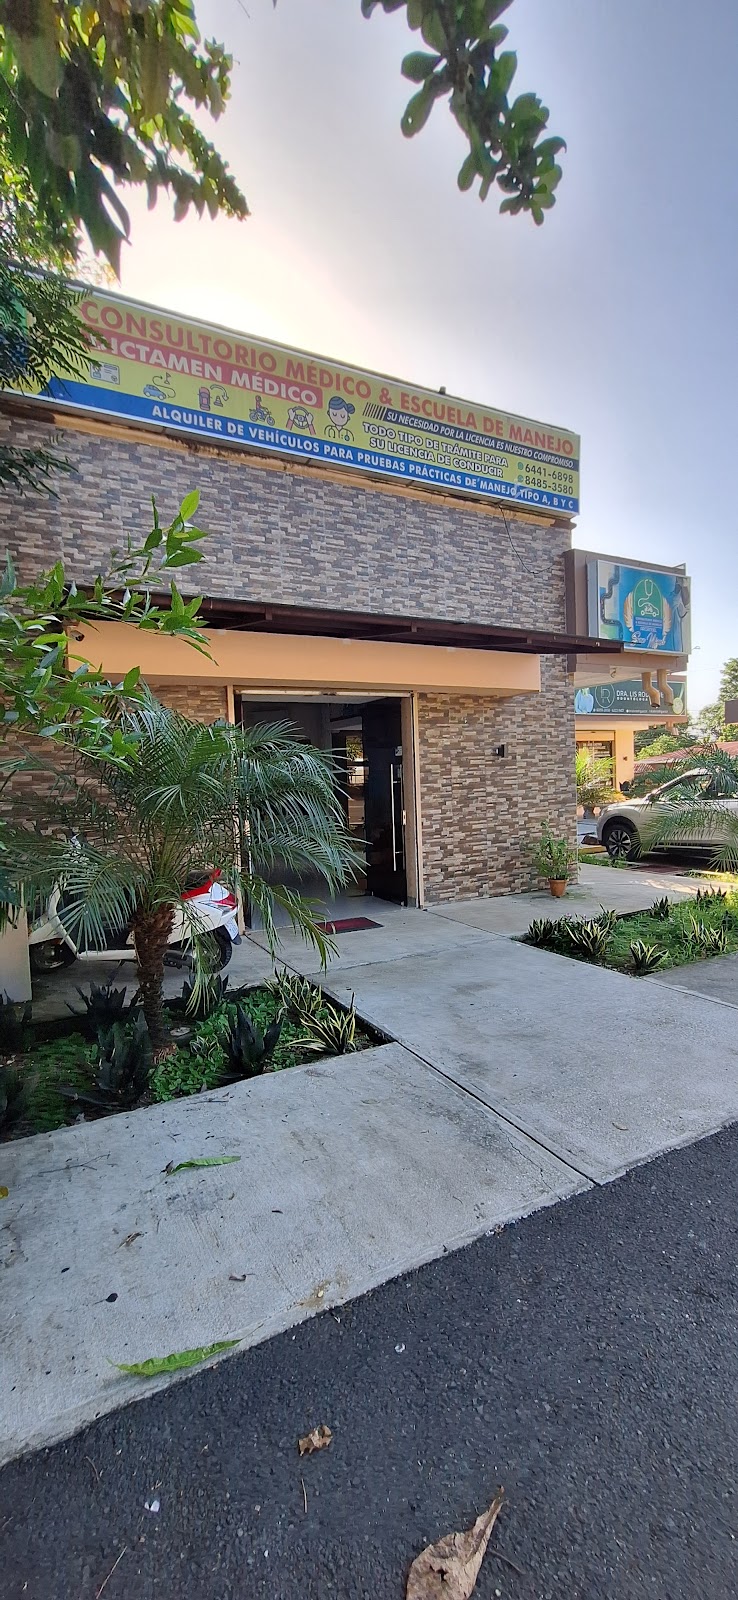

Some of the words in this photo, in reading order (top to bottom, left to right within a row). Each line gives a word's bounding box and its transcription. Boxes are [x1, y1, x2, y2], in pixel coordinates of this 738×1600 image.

[81, 301, 277, 373] CONSULTORIO
[285, 358, 371, 400] MÉDICO
[379, 387, 393, 406] &
[401, 392, 477, 430] ESCUELA
[483, 416, 503, 437] DE
[509, 424, 574, 456] MANEJO
[231, 371, 317, 406] MÉDICO
[362, 422, 396, 439] TODO
[398, 431, 423, 446] TIPO
[426, 438, 439, 450] DE
[441, 442, 482, 461] TRÁMITE
[484, 453, 508, 468] PARA
[387, 411, 398, 422] SU
[398, 414, 439, 433] NECESIDAD
[440, 426, 454, 438] POR
[455, 430, 464, 441] LA
[465, 432, 495, 448] LICENCIA
[496, 440, 504, 450] ES
[505, 442, 532, 458] NUESTRO
[152, 405, 223, 431] ALQUILER
[227, 422, 244, 436] DE
[249, 427, 320, 453] VEHÍCULOS
[323, 445, 354, 461] PARA
[357, 452, 406, 472] PRUEBAS
[409, 464, 462, 484] PRÁCTICAS
[465, 478, 477, 487] DE
[480, 481, 517, 497] MANEJO
[520, 489, 540, 501] TIPO
[542, 495, 551, 506] A,
[553, 498, 559, 507] B
[561, 499, 566, 507] Y
[568, 500, 574, 509] C
[369, 437, 385, 450] SU
[388, 441, 436, 462] LICENCIA
[437, 454, 451, 466] DE
[452, 456, 504, 478] CONDUCIR
[525, 463, 574, 484] 6441-6898
[525, 475, 574, 496] 8485-3580
